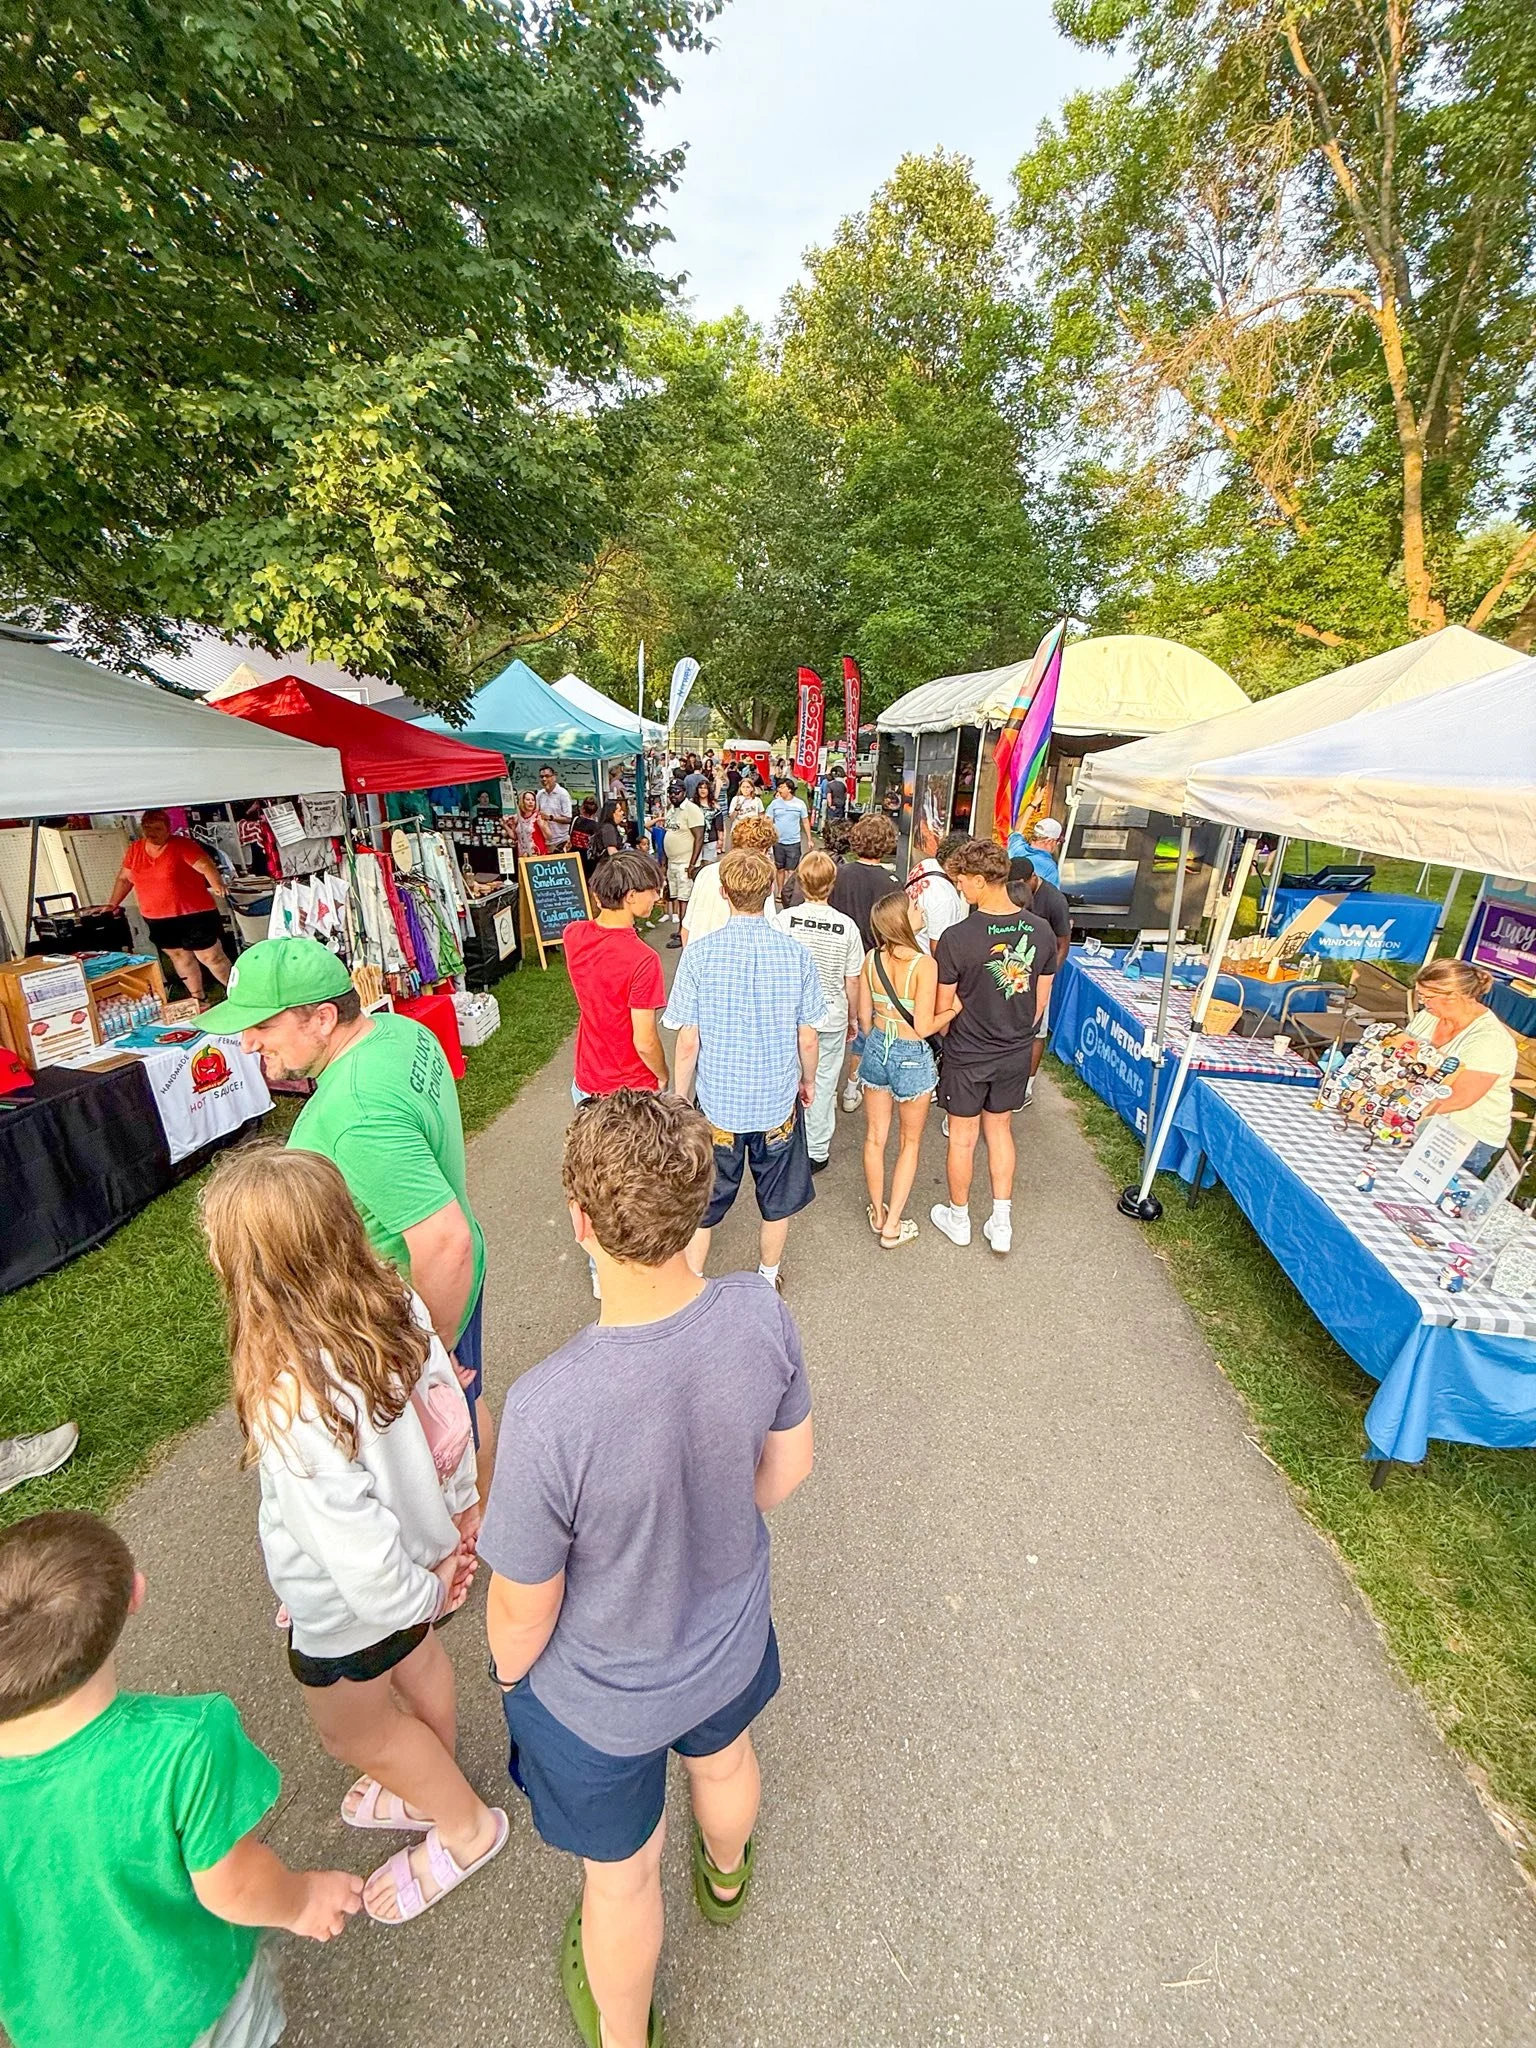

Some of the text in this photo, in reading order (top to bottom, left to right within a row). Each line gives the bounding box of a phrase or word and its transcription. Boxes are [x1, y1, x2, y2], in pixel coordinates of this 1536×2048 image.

[799, 711, 808, 764] WHOLESALE
[804, 685, 823, 768] COSTCO
[532, 876, 572, 889] Smokers
[533, 861, 569, 877] Drink
[540, 909, 568, 923] Custom
[790, 915, 845, 935] FORD
[988, 920, 1034, 935] Mauna Kea
[1319, 937, 1401, 949] WINDOW NATION
[1490, 916, 1536, 951] Lucy
[1096, 1006, 1143, 1061] SW METRO
[161, 1054, 190, 1094] HANDMADE
[410, 1028, 430, 1094] GET LUCKY
[428, 1046, 445, 1106] TONIGHT
[190, 1097, 207, 1113] HOT
[213, 1081, 244, 1099] SAUCE!
